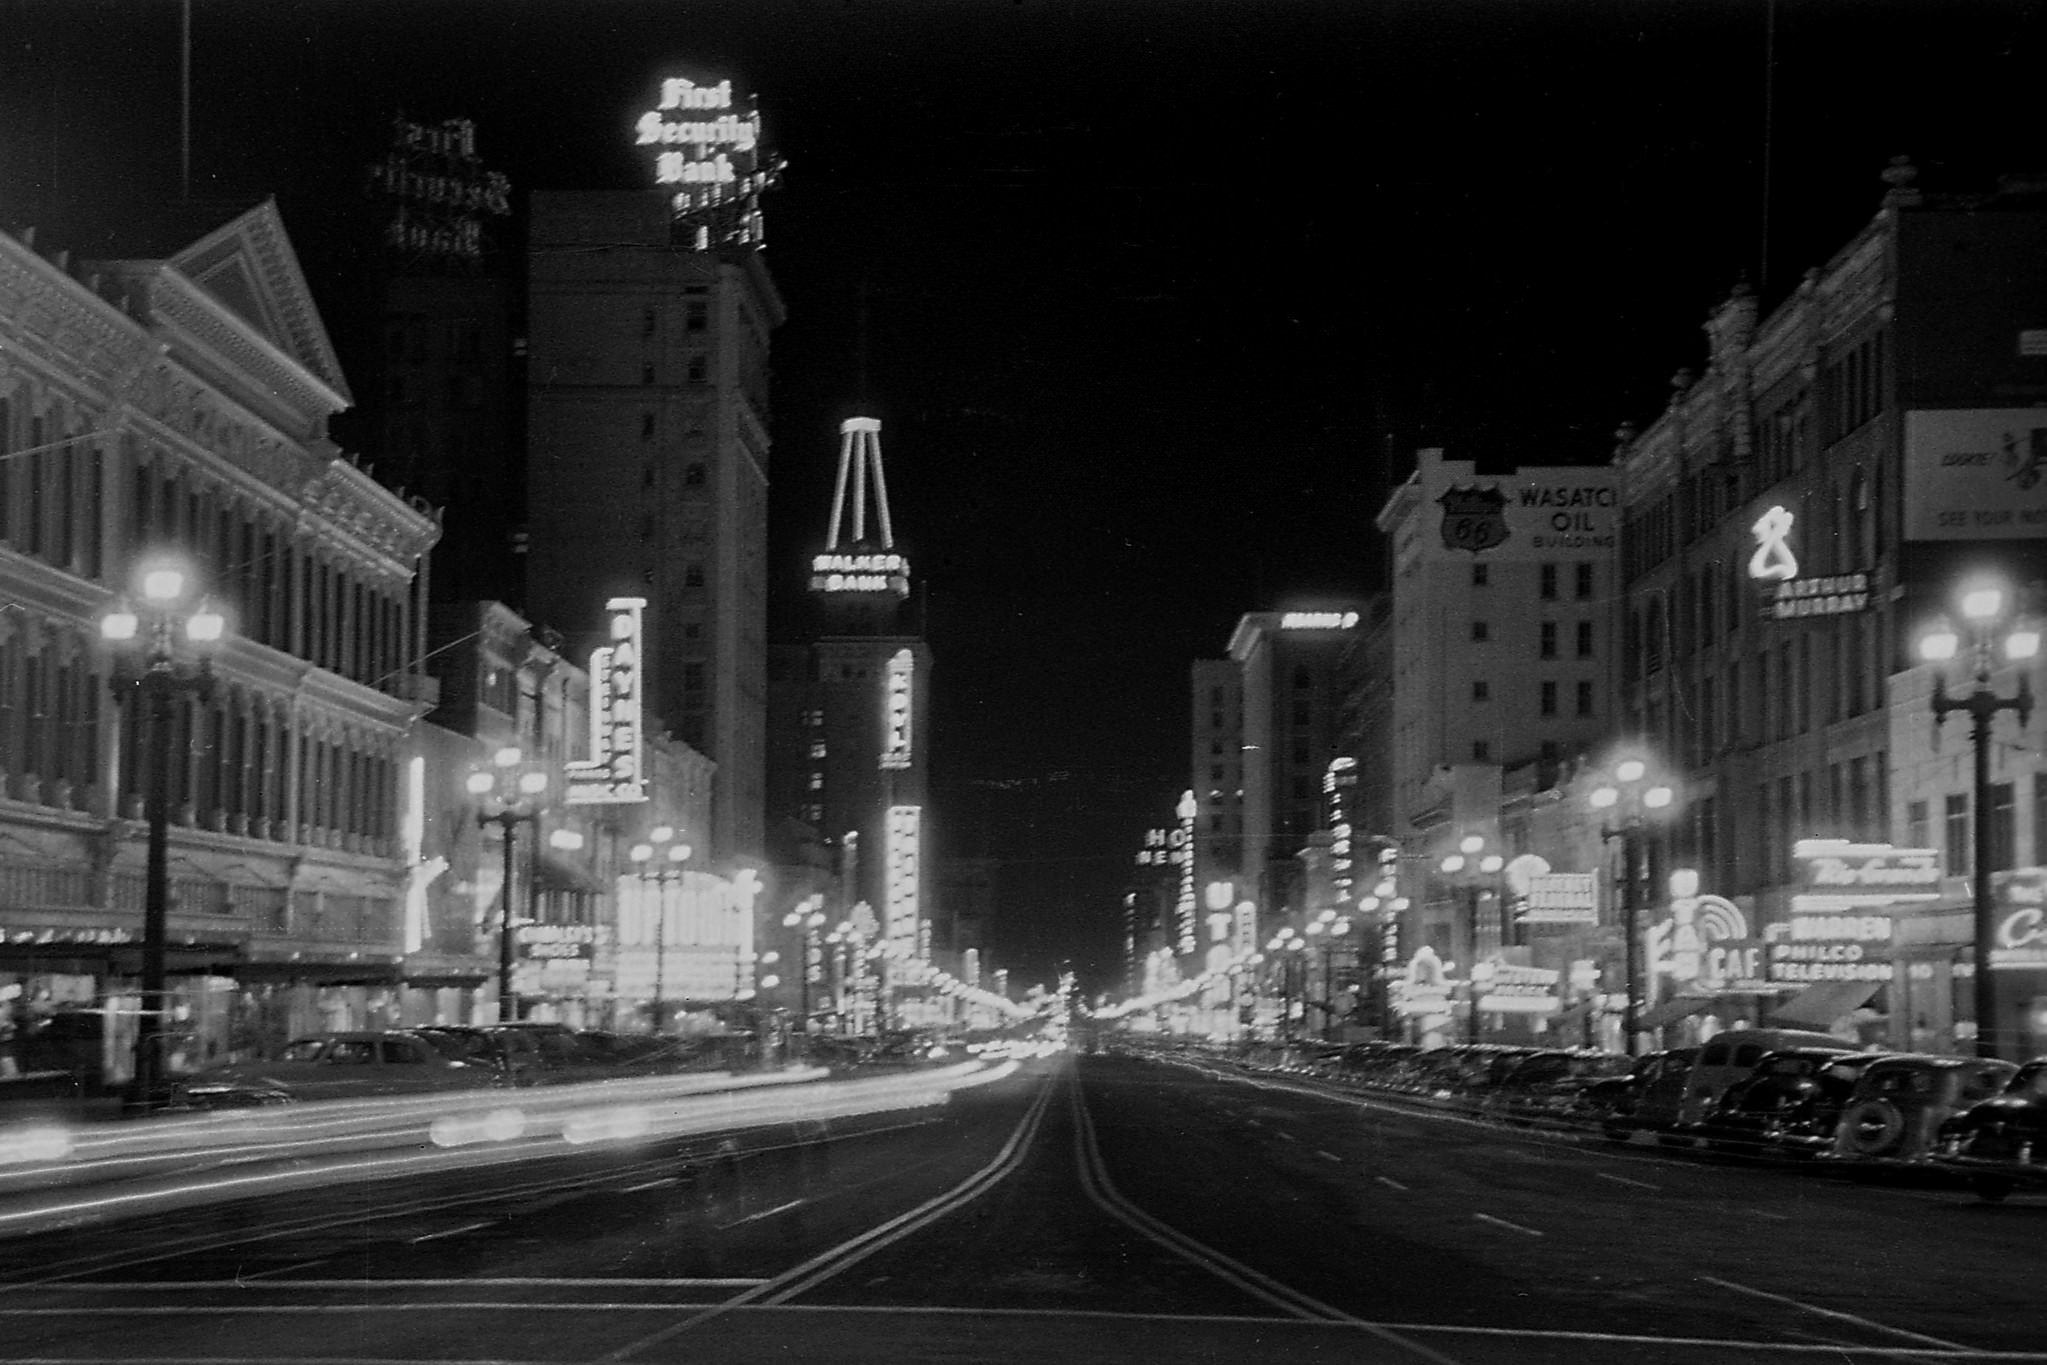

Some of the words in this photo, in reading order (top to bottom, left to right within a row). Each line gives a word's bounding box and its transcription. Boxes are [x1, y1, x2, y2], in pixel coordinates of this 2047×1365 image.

[657, 78, 732, 109] First
[635, 111, 756, 151] Security
[656, 151, 736, 184] Bank
[1455, 516, 1493, 546] 66
[1551, 512, 1595, 532] OIL
[1533, 536, 1616, 549] BUILDING
[813, 554, 902, 572] WALKER
[824, 574, 889, 592] BANK
[1773, 944, 1864, 961] PHILCO
[1709, 947, 1760, 979] CAF
[1773, 962, 1894, 980] TELEVISION
